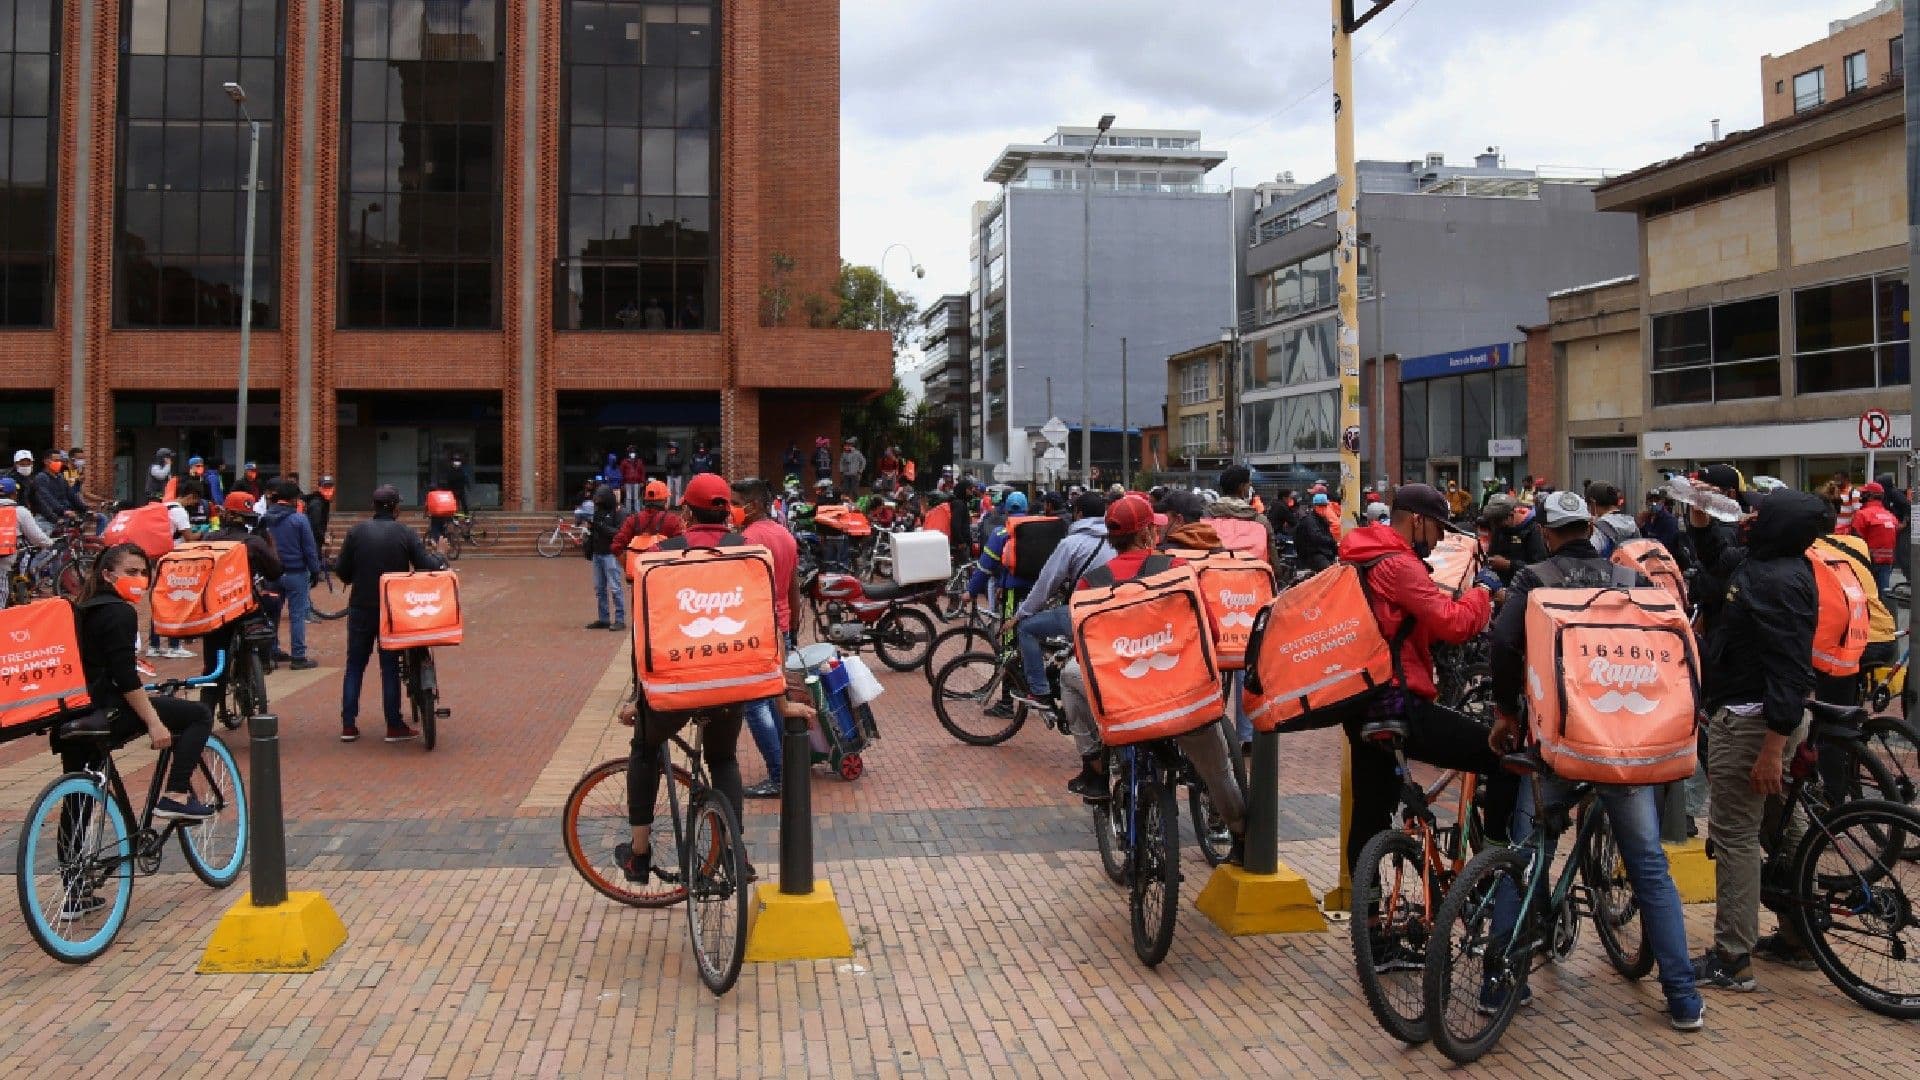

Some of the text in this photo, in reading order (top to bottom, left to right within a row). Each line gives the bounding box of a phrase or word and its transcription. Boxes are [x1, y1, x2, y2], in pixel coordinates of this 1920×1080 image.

[403, 589, 441, 605] Rappi
[676, 586, 744, 615] Rappi
[1219, 589, 1256, 610] Rappi
[1112, 622, 1174, 658] Rappi
[1292, 646, 1319, 663] CON
[1588, 656, 1659, 689] Rappi
